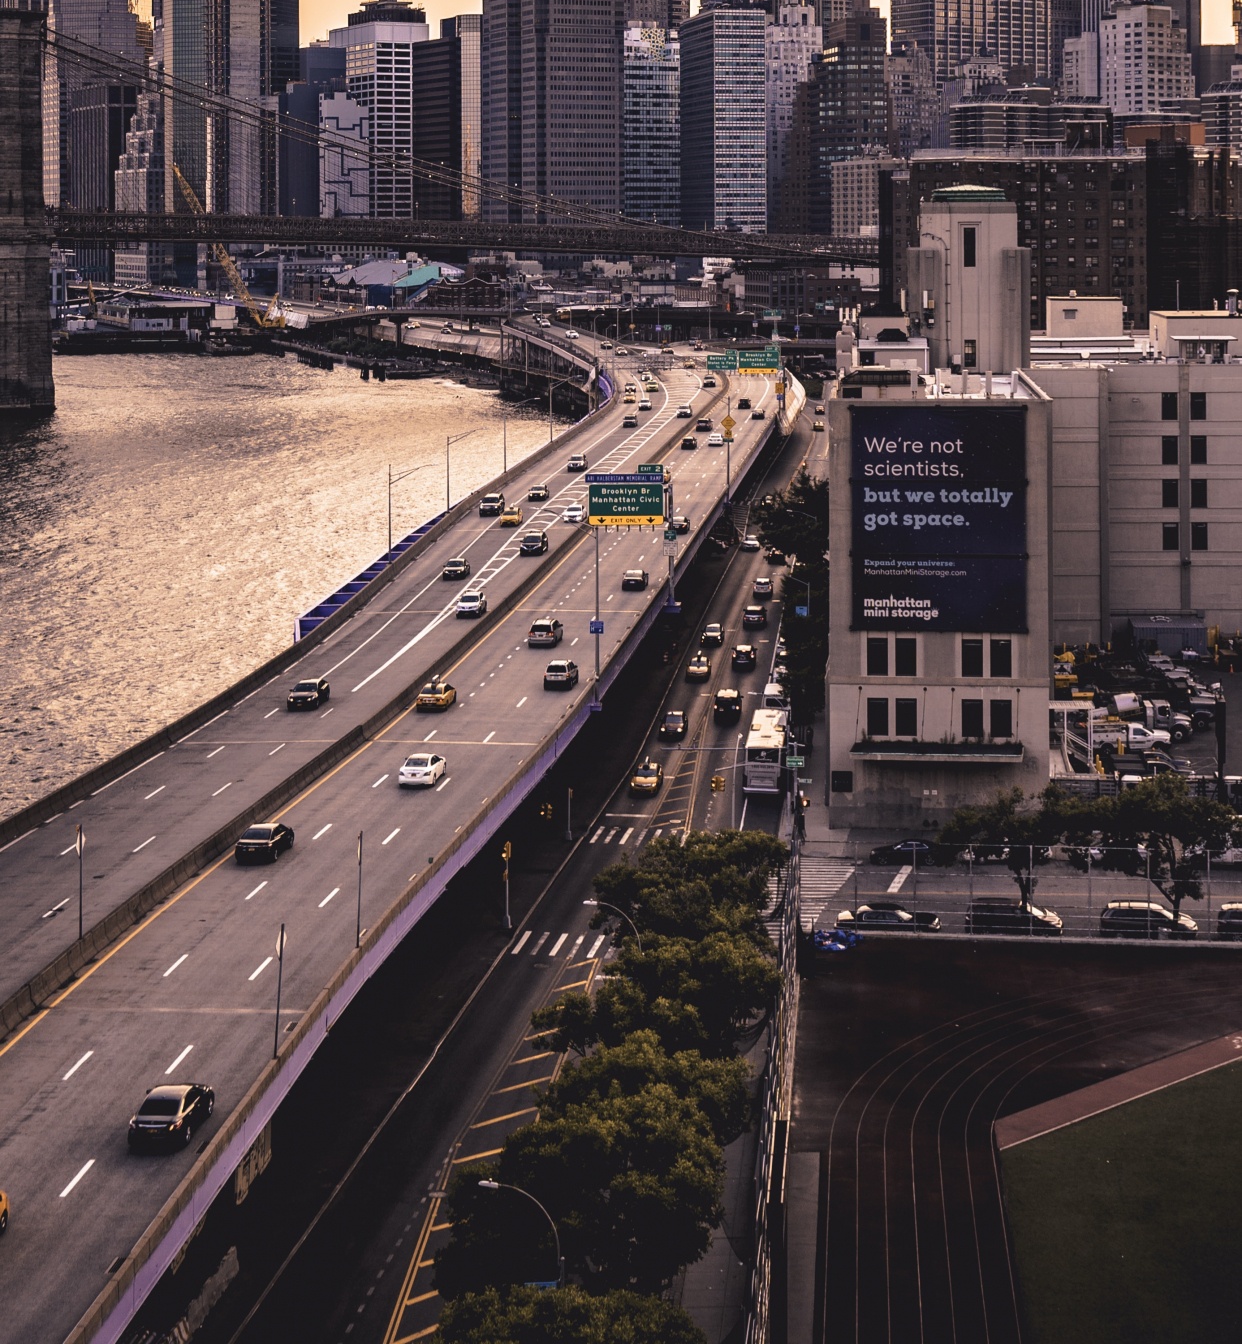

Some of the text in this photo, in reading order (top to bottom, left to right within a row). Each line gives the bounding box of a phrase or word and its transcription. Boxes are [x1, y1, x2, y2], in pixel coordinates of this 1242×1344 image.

[864, 437, 964, 453] We're not
[864, 460, 964, 478] scientists,
[864, 488, 1013, 507] but we totally
[864, 512, 970, 531] got space.
[864, 559, 956, 568] Expand your universe:
[864, 568, 967, 577] ManhattanMiniStorage.com
[864, 594, 931, 608] manhattan
[864, 607, 939, 620] mini storage
